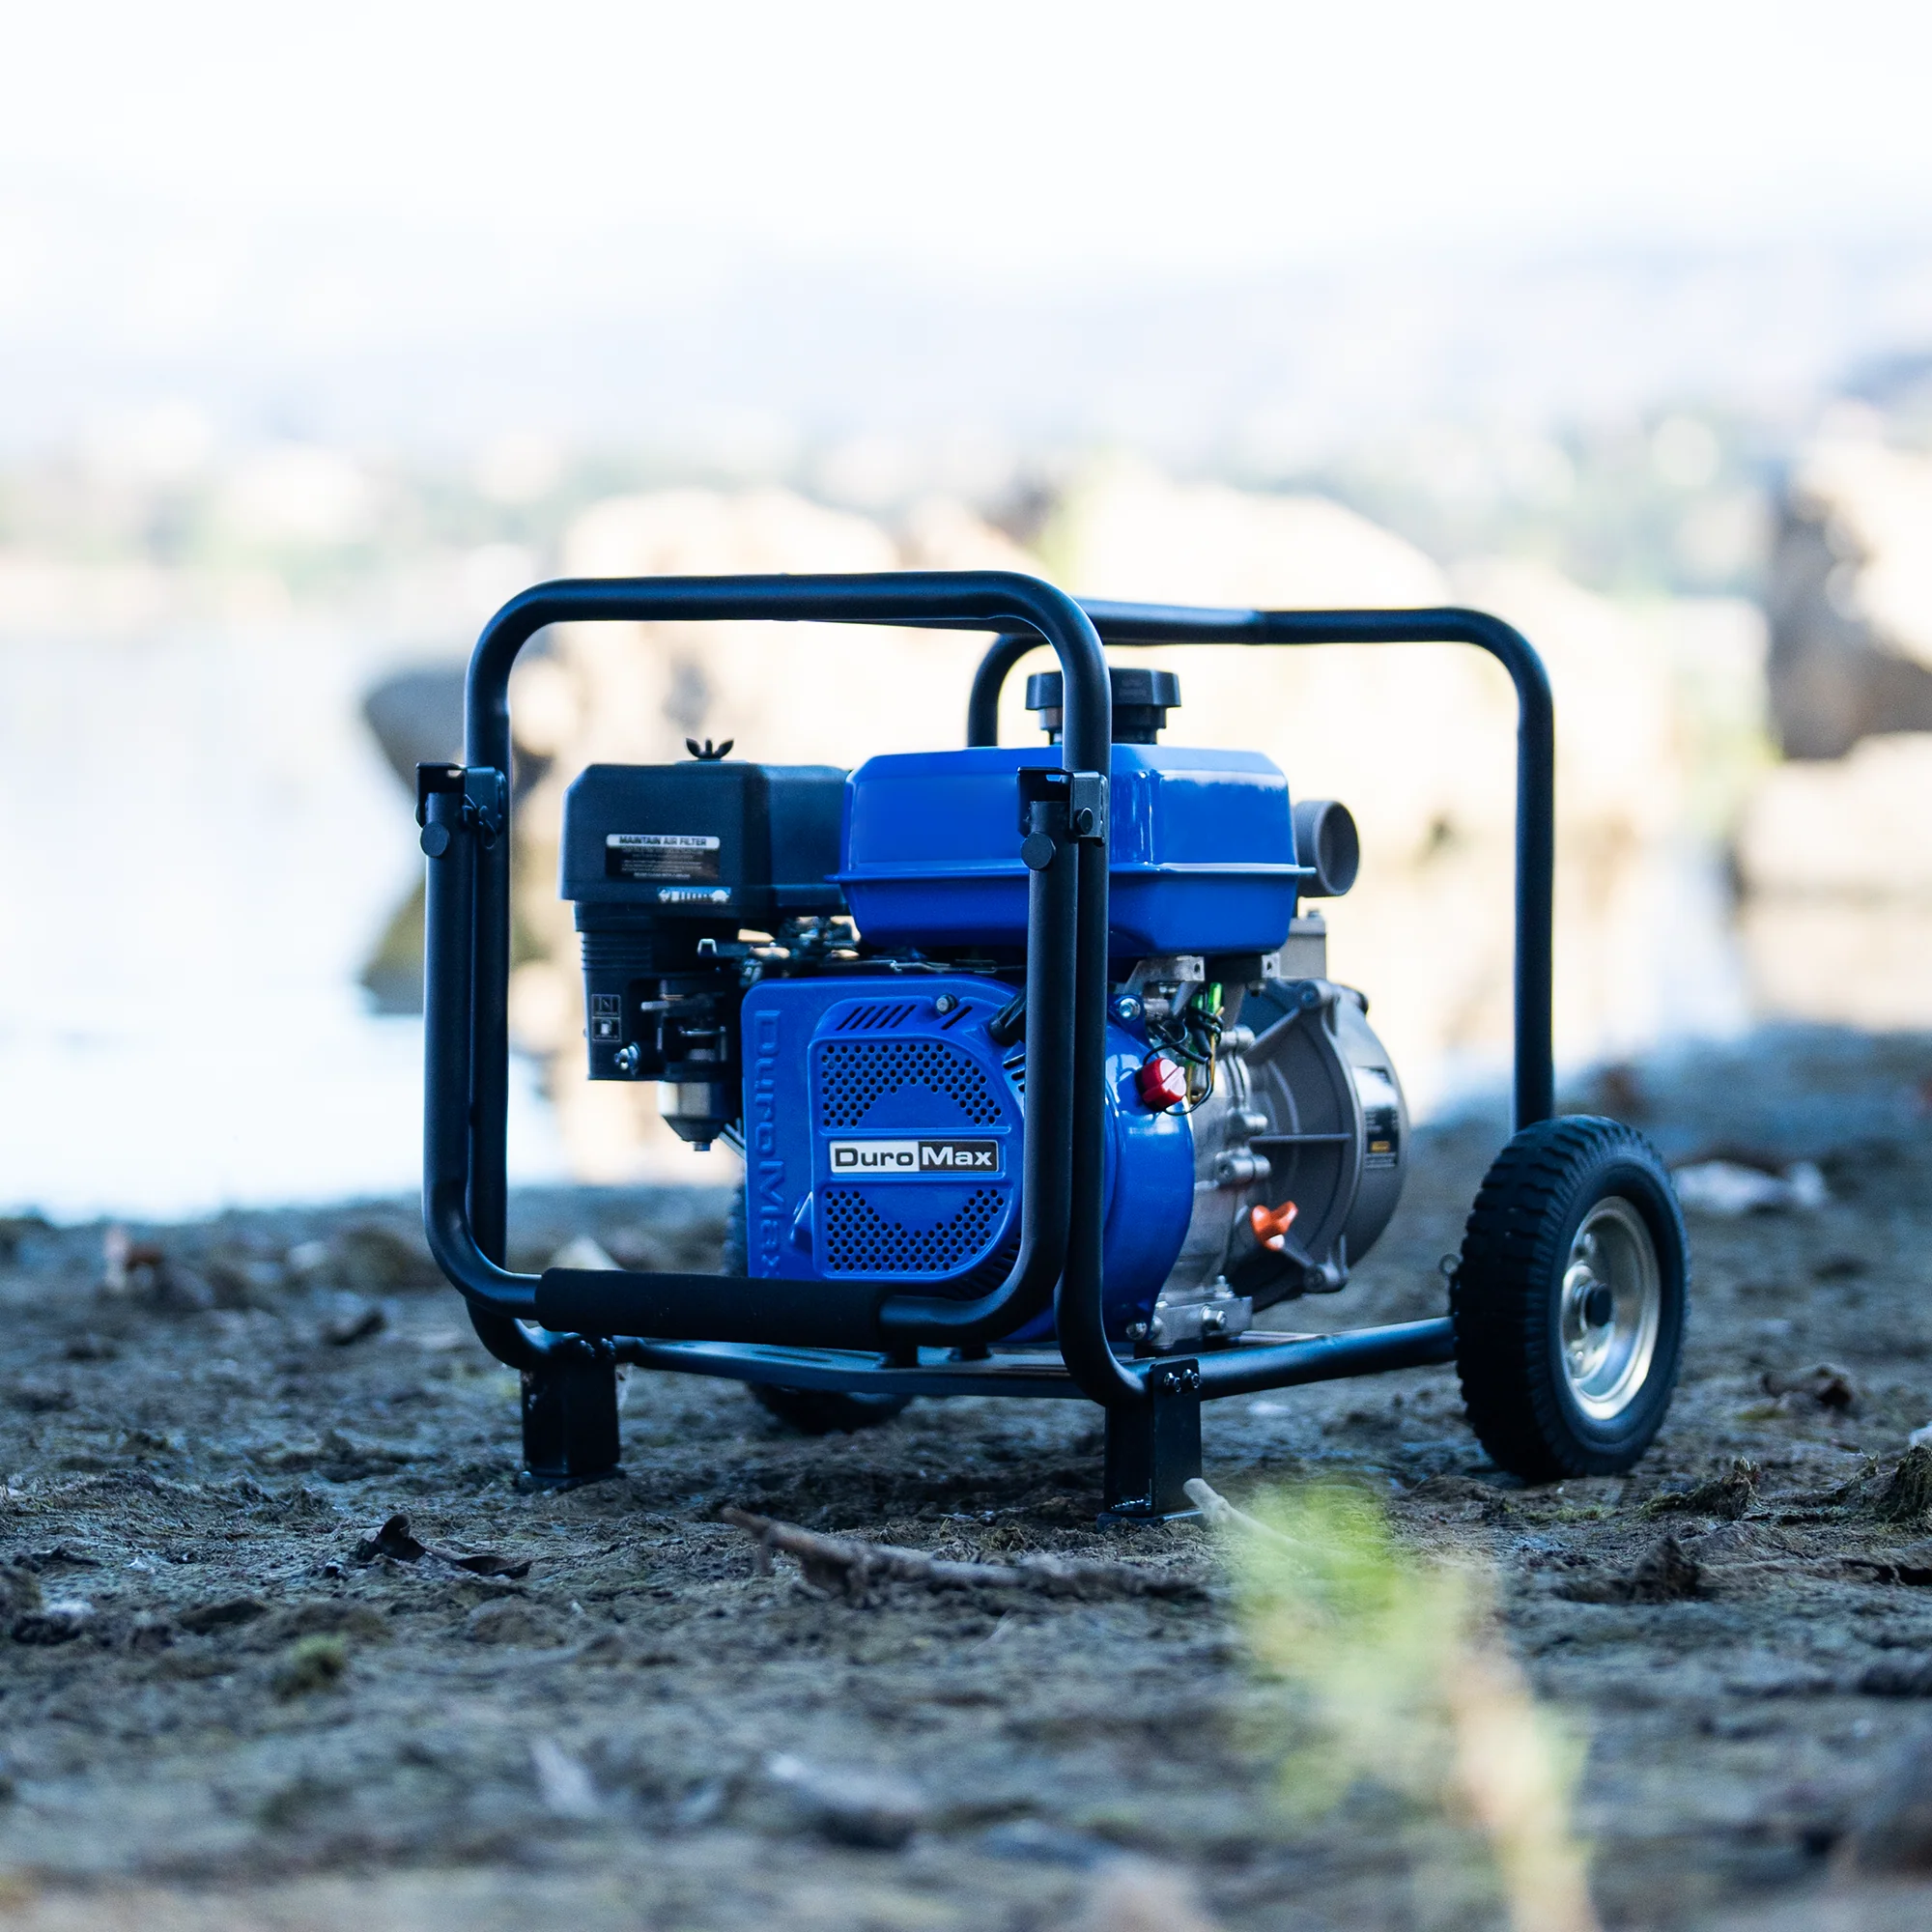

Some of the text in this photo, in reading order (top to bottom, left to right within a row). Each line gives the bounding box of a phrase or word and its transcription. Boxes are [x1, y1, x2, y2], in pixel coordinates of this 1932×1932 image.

[619, 836, 707, 846] MAINTAIN AIR FILTER
